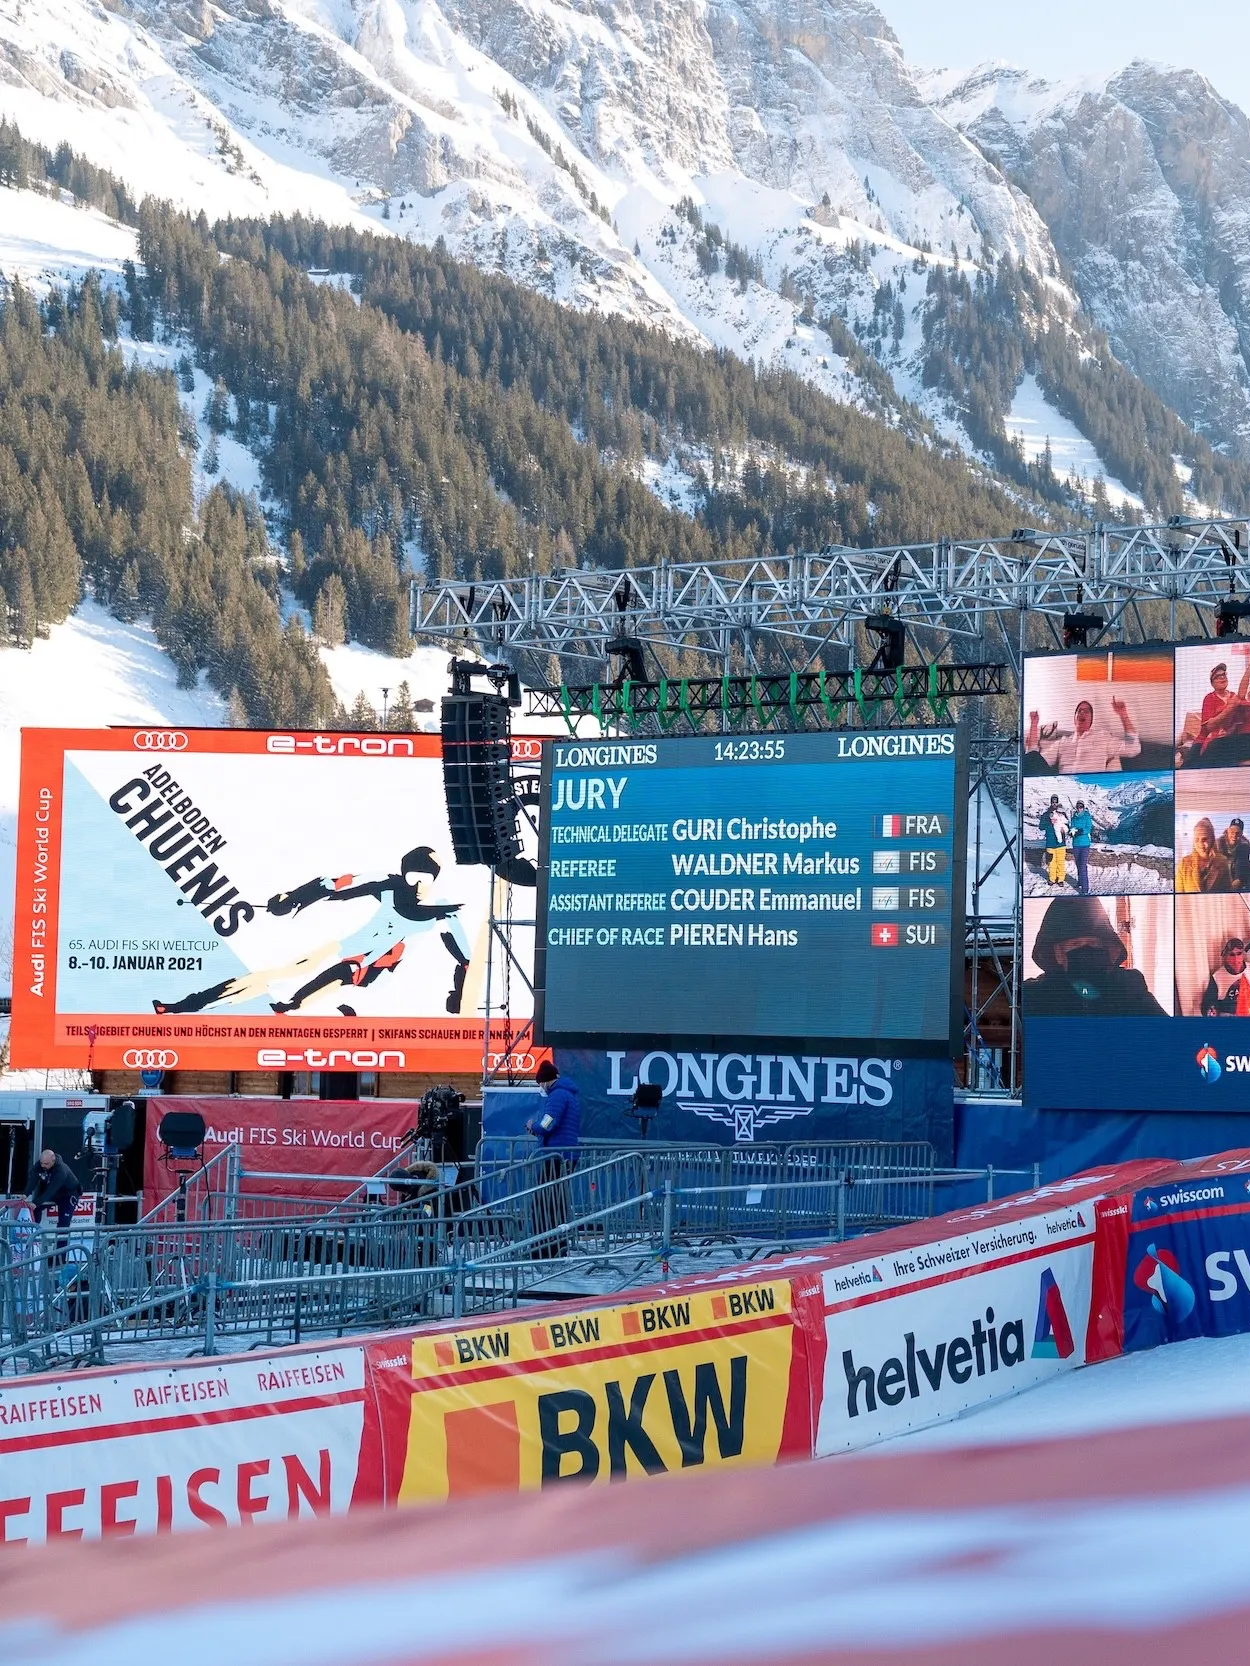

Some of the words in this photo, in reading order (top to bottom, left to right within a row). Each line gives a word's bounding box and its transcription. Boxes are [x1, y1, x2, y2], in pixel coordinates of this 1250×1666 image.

[266, 735, 414, 756] e-tron
[556, 744, 658, 768] LONGINES
[714, 740, 786, 761] 14:23:55
[837, 734, 955, 758] LONGINES
[35, 787, 54, 823] Cup
[142, 763, 228, 855] ADELBODEN
[551, 777, 628, 811] JURY
[552, 824, 611, 844] TECHNICAL
[613, 822, 668, 842] DELEGATE
[672, 818, 722, 842] GURI
[726, 815, 837, 844] Christophe
[905, 815, 942, 835] FRA
[33, 827, 50, 884] World
[108, 777, 255, 938] CHUENIS
[550, 860, 617, 878] REFEREE
[672, 853, 779, 876] WALDNER
[783, 851, 860, 876] Markus
[910, 851, 937, 871] FIS
[32, 888, 48, 914] Ski
[549, 893, 613, 912] ASSISTANT
[615, 892, 667, 912] REFEREE
[670, 888, 755, 912] COUDER
[759, 887, 862, 911] Emmanuel
[909, 888, 936, 908] FIS
[31, 919, 48, 949] FIS
[68, 939, 85, 950] 65.
[88, 939, 119, 950] AUDI
[122, 939, 139, 951] FIS
[141, 940, 160, 951] SKI
[163, 940, 219, 952] WELTCUP
[548, 928, 593, 946] CHIEF
[597, 928, 618, 946] OF
[621, 928, 665, 946] RACE
[670, 923, 744, 947] PIEREN
[748, 923, 798, 947] Hans
[905, 926, 936, 944] SUI
[29, 953, 46, 998] Audi
[112, 956, 165, 971] JANUAR
[168, 957, 203, 971] 2021
[66, 1025, 130, 1037] TEILSIGEBIET
[132, 1026, 172, 1037] CHUENIS
[174, 1026, 193, 1037] UND
[195, 1024, 232, 1038] HÖCHST
[234, 1027, 247, 1038] AN
[248, 1027, 266, 1038] DEN
[268, 1027, 321, 1039] RENNTAGEN
[323, 1028, 368, 1039] GESPERRT
[378, 1028, 417, 1040] SKIFANS
[418, 1029, 461, 1040] SCHAUEN
[462, 1030, 477, 1041] DIE
[478, 1030, 514, 1041] RNNEN
[256, 1048, 406, 1068] e-tron
[605, 1050, 894, 1107] LONGINES
[204, 1126, 244, 1143] Audi
[249, 1127, 277, 1145] FIS
[281, 1128, 307, 1146] Ski
[311, 1129, 365, 1148] World
[370, 1131, 403, 1153] Cup
[1159, 1184, 1225, 1208] swisscom
[834, 1270, 873, 1292] helvetia
[893, 1259, 916, 1277] Ihre
[917, 1246, 971, 1271] Schweizer
[971, 1230, 1037, 1262] Versicherung.
[1046, 1215, 1078, 1236] helvetia
[728, 1287, 775, 1317] BKW
[642, 1302, 691, 1333] BKW
[549, 1317, 601, 1349] BKW
[456, 1332, 510, 1365] BKW
[842, 1306, 1025, 1418] helvetia
[256, 1362, 345, 1393] RAIFFEISEN
[134, 1378, 229, 1408] RAIFFEISEN
[0, 1393, 102, 1426] RAIFFEISEN
[537, 1354, 748, 1492] BKW
